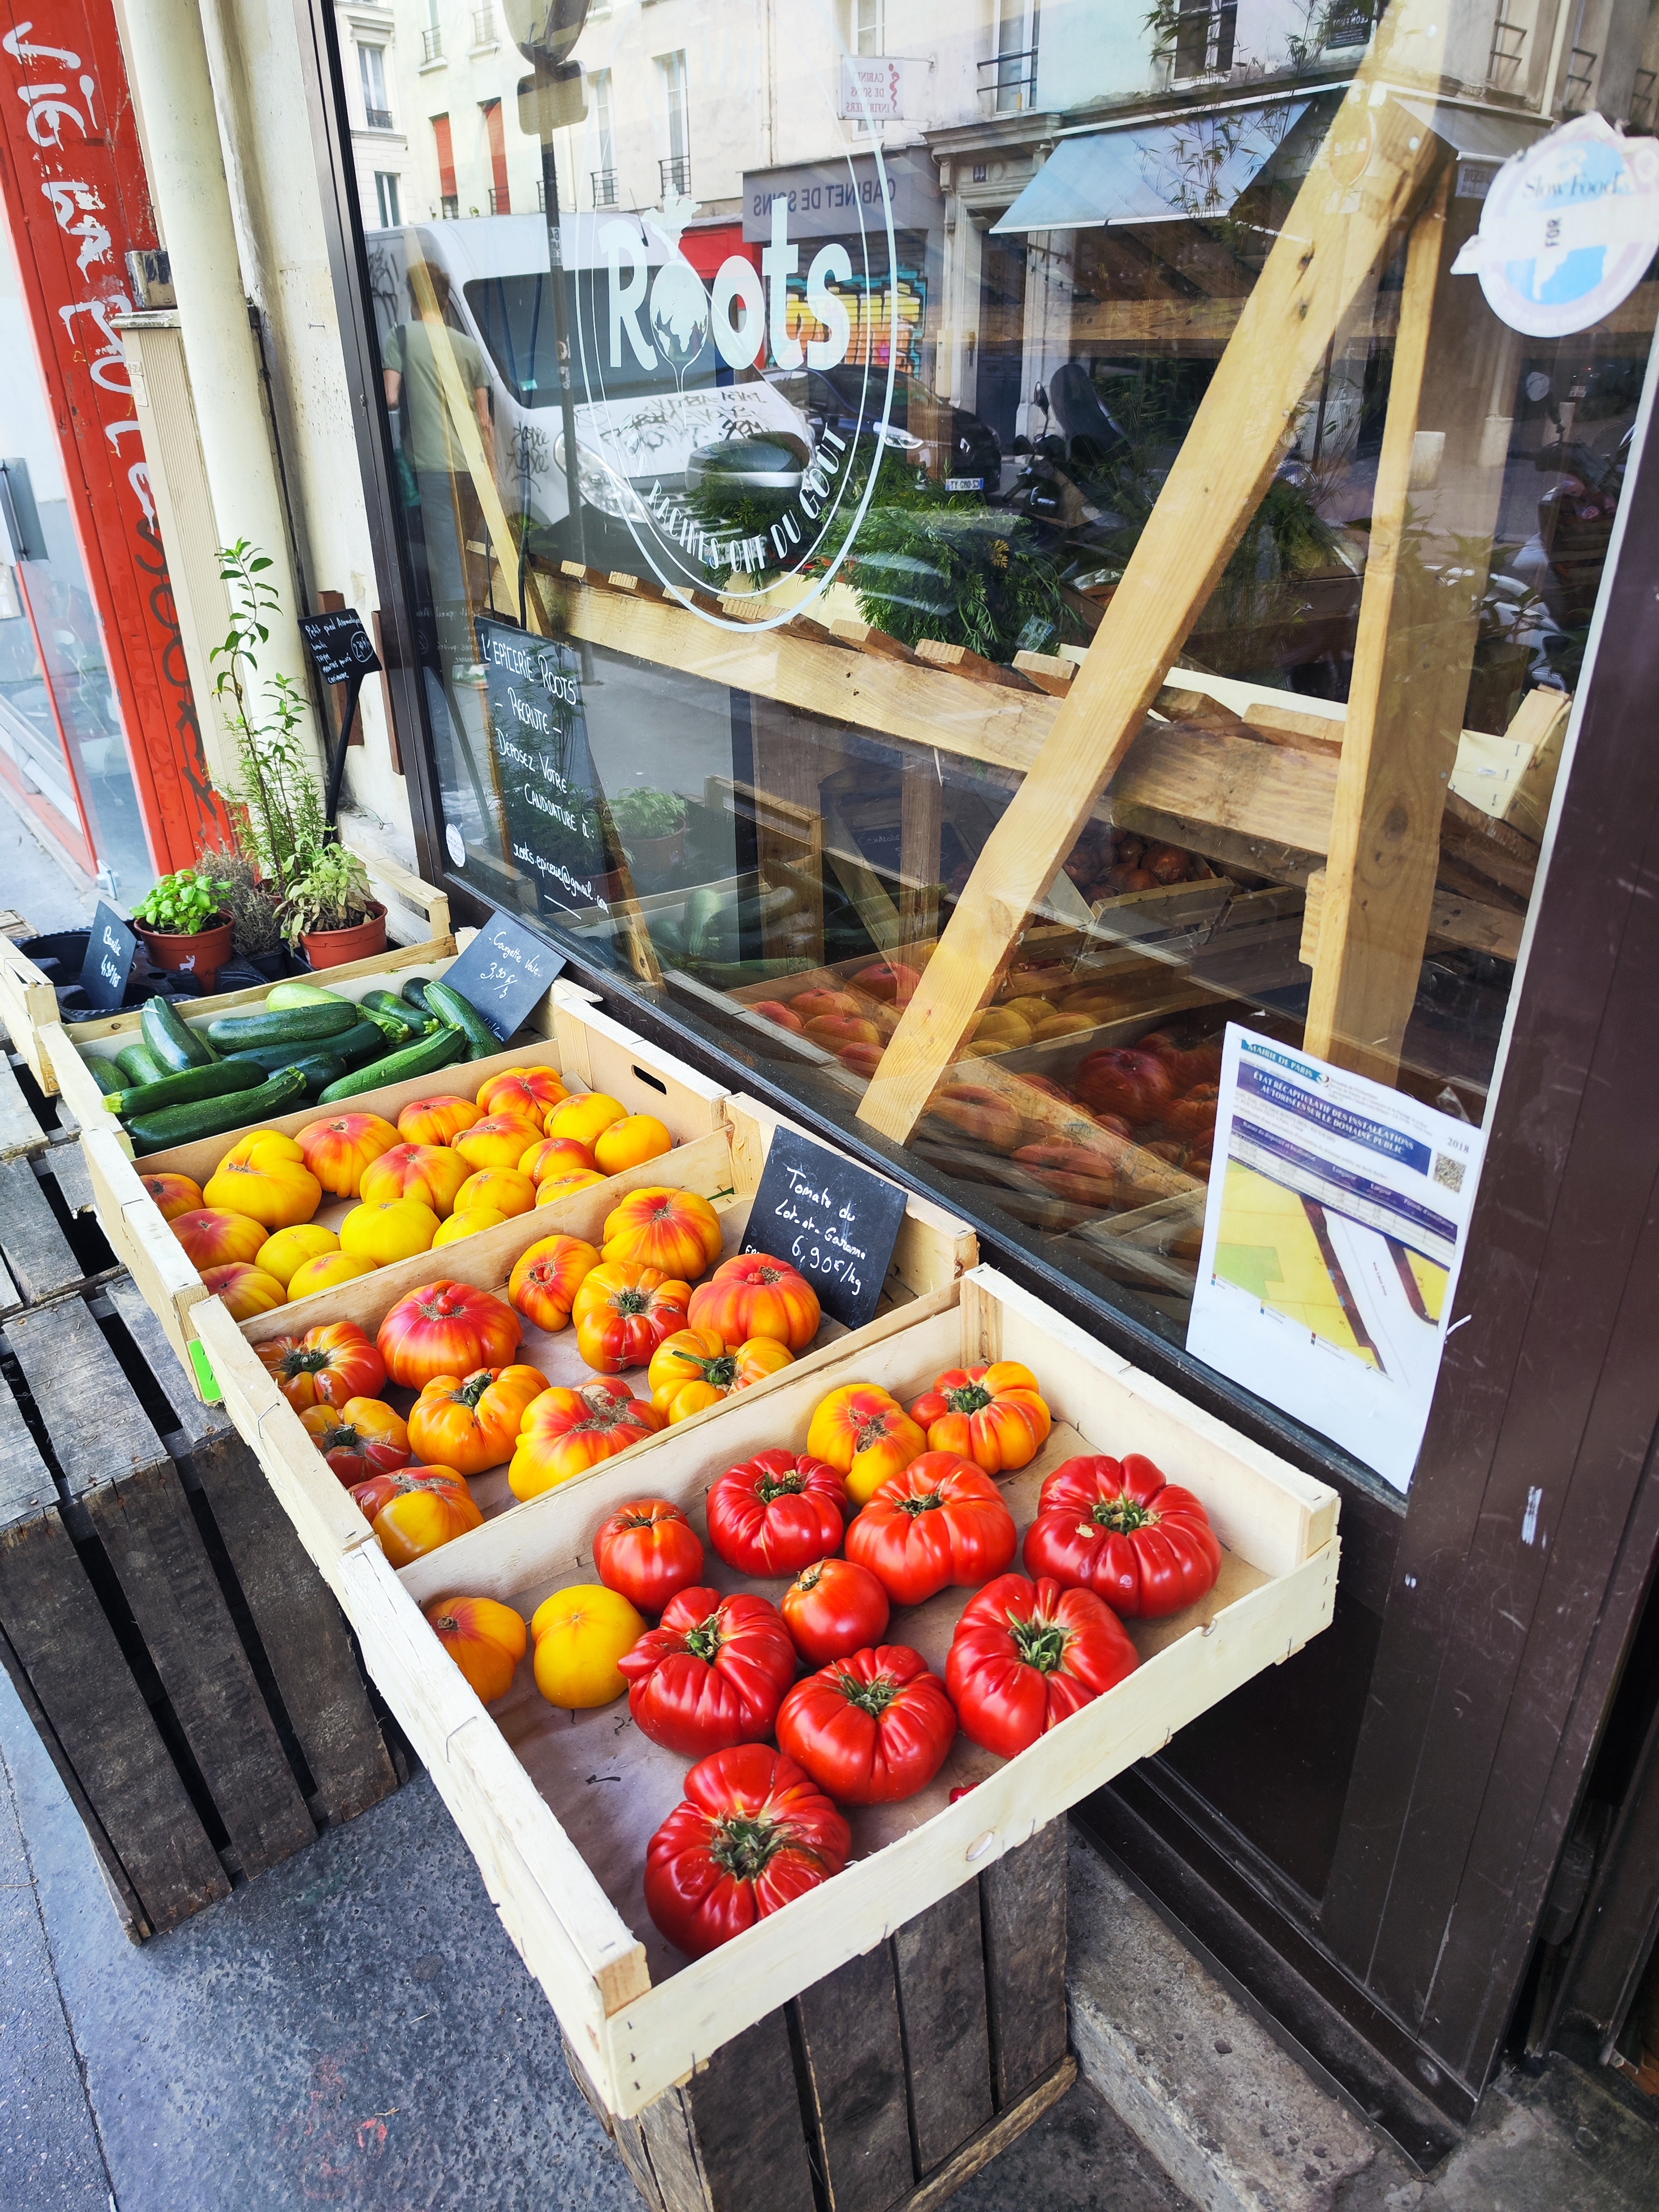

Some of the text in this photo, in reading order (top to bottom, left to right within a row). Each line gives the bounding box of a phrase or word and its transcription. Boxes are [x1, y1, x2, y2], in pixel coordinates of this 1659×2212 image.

[1522, 170, 1620, 199] Slow Food
[598, 197, 852, 371] Roots
[648, 479, 722, 570] RACINES
[729, 534, 766, 574] ONT
[771, 509, 801, 559] DU
[1446, 1137, 1469, 1154] 2018
[787, 1166, 832, 1209] Tomate
